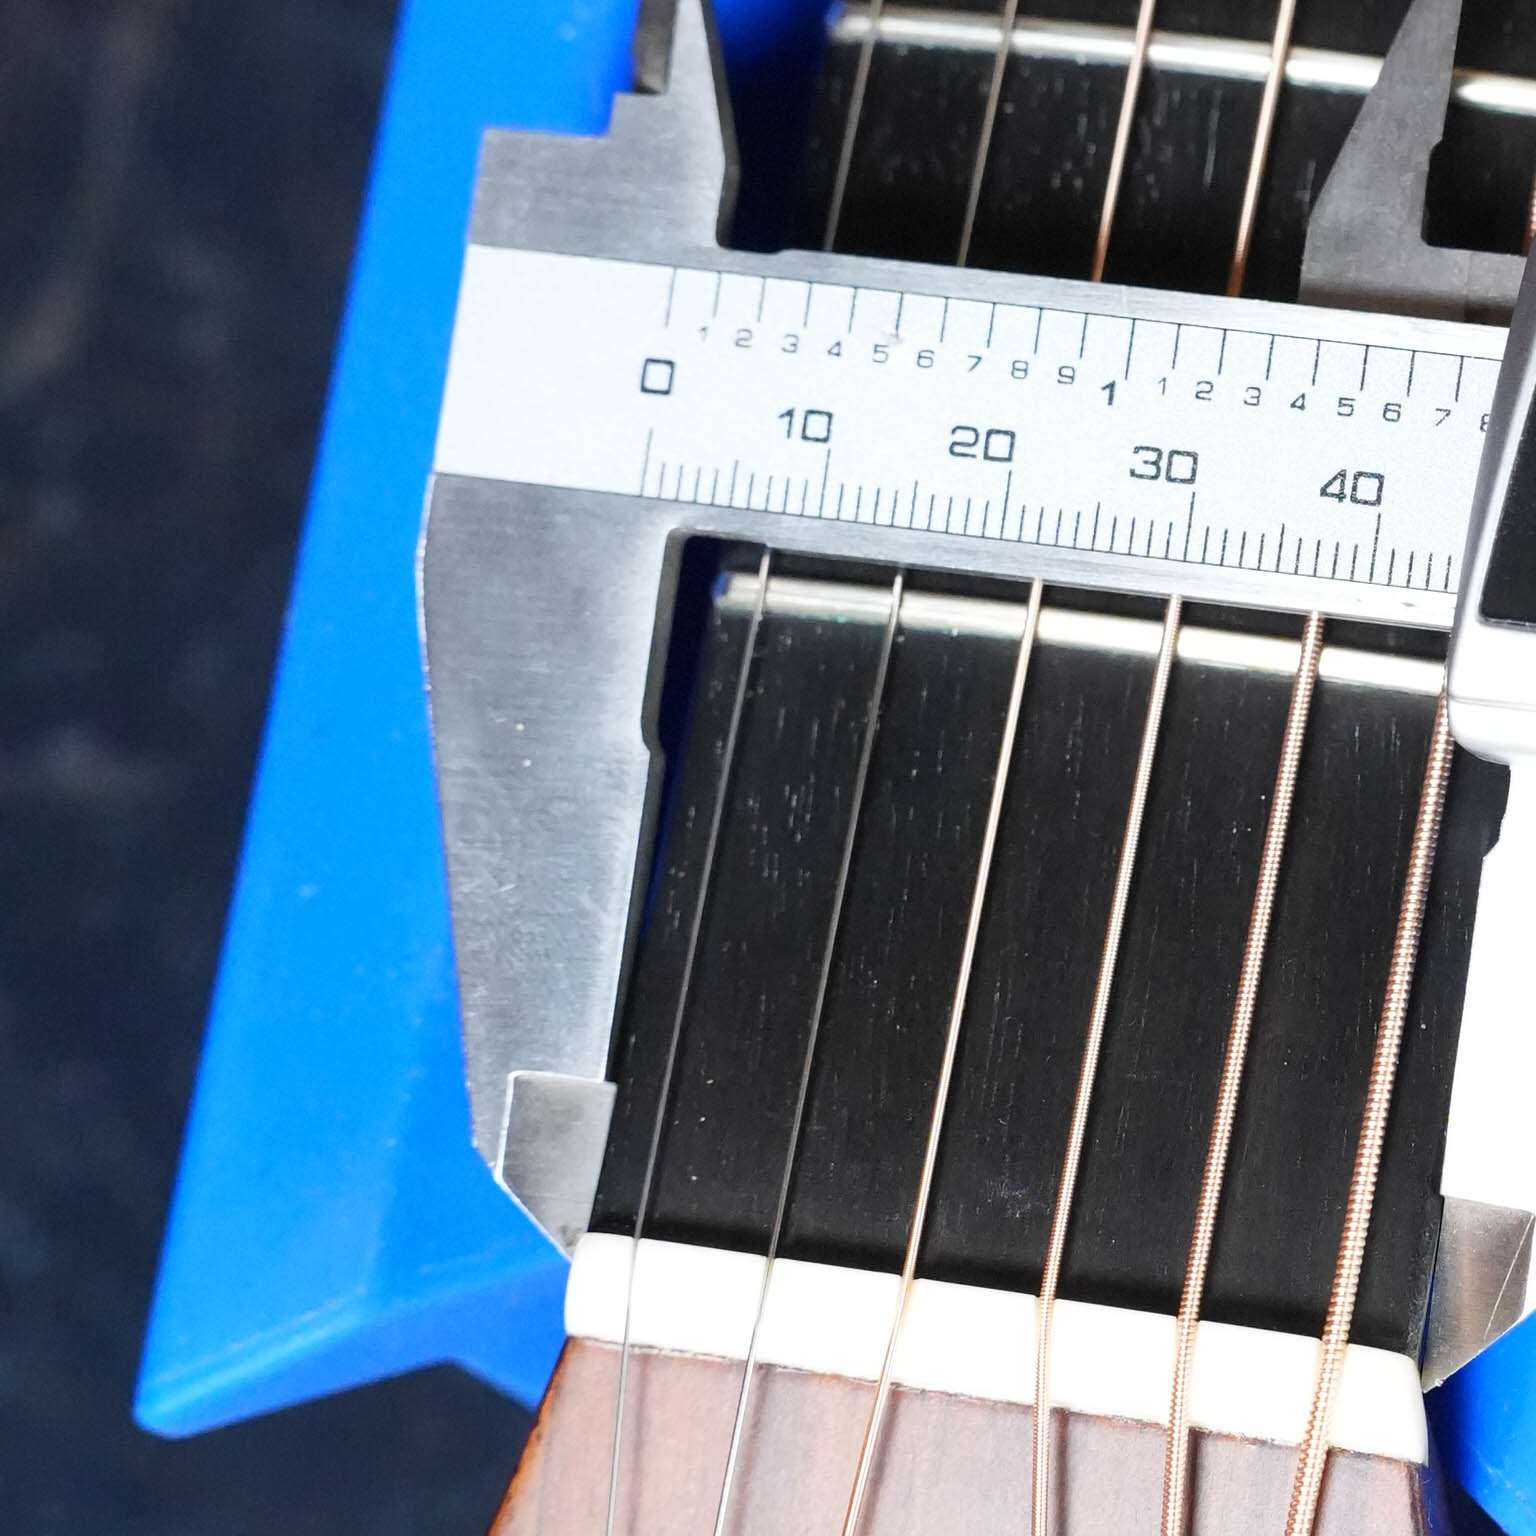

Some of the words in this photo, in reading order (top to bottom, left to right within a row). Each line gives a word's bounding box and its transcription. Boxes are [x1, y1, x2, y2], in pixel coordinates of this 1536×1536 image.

[640, 357, 677, 397] 0
[777, 407, 835, 445] 10
[948, 424, 1017, 464] 20
[1128, 445, 1200, 486] 30
[1319, 468, 1386, 508] 40
[734, 328, 753, 349] 2
[781, 333, 800, 354] 3
[826, 340, 843, 358] 4
[872, 343, 889, 364] 5
[916, 349, 936, 369] 6
[967, 354, 983, 372] 7
[1010, 359, 1030, 380] 8
[1056, 365, 1076, 385] 9
[1100, 379, 1117, 407] 1
[1157, 376, 1167, 397] 1
[1194, 380, 1215, 402] 2
[1242, 386, 1262, 407] 3
[1289, 392, 1307, 412] 4
[1336, 396, 1357, 418] 5
[1382, 402, 1403, 424] 6
[1434, 407, 1452, 427] 7
